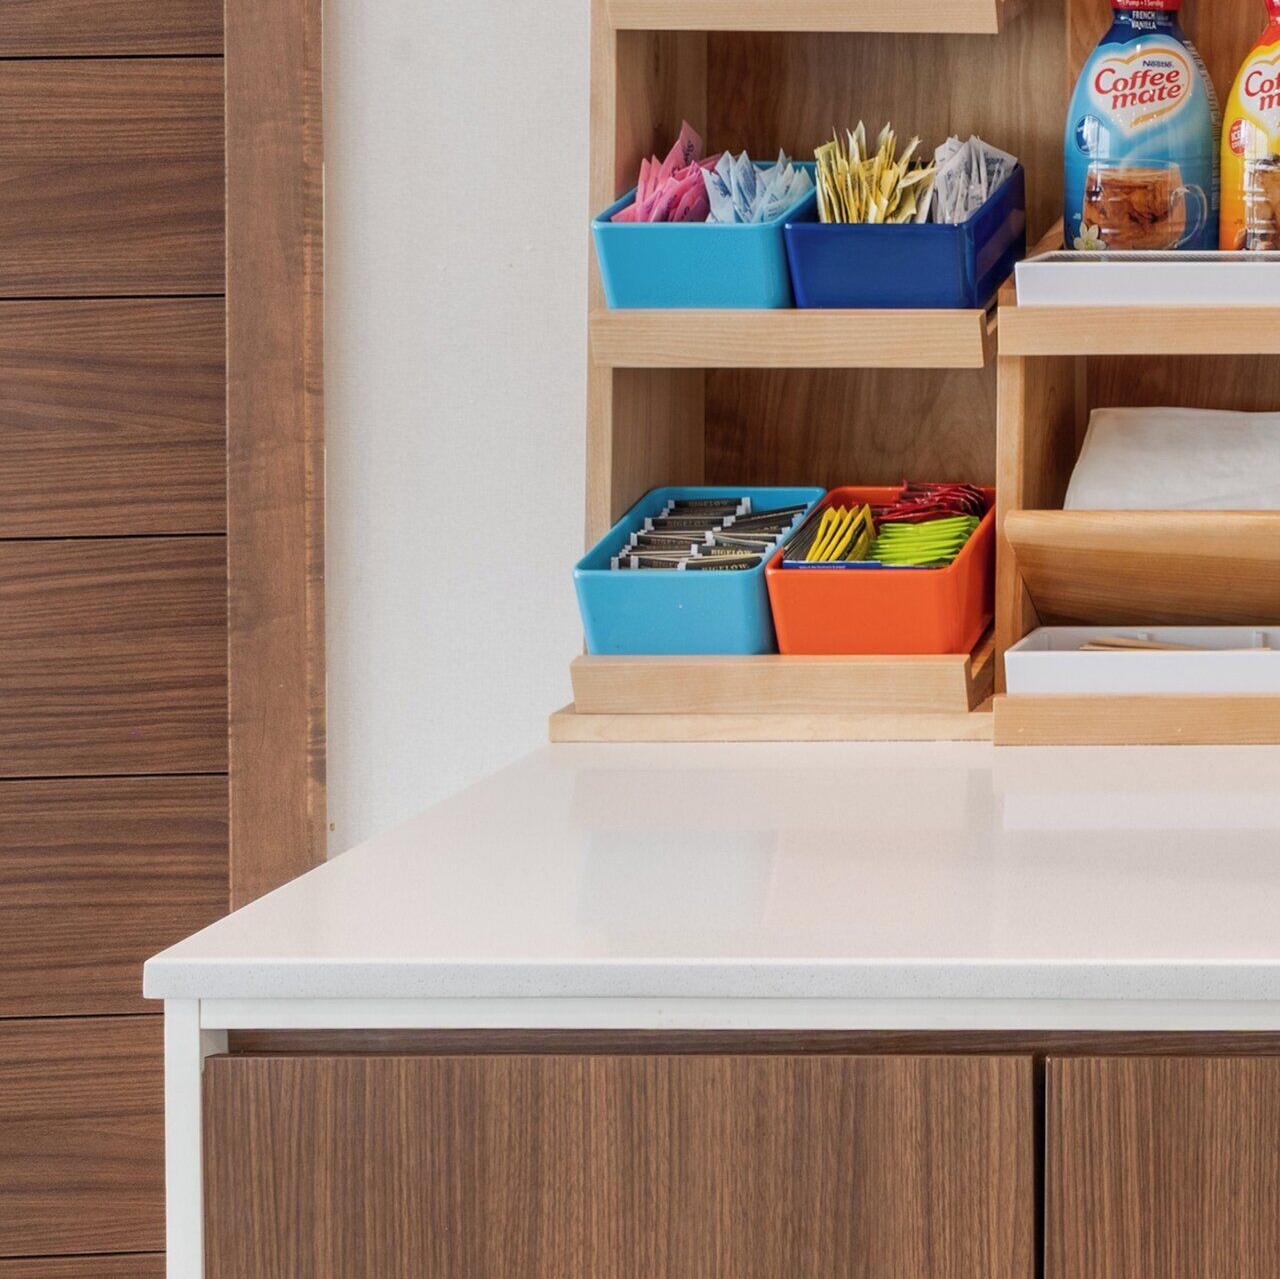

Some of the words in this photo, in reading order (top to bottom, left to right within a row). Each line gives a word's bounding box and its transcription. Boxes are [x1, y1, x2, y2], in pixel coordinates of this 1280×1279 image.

[1132, 10, 1156, 20] FRENCH
[1131, 20, 1157, 30] VANILLA
[1094, 67, 1180, 95] Coffee
[1112, 84, 1182, 110] mate
